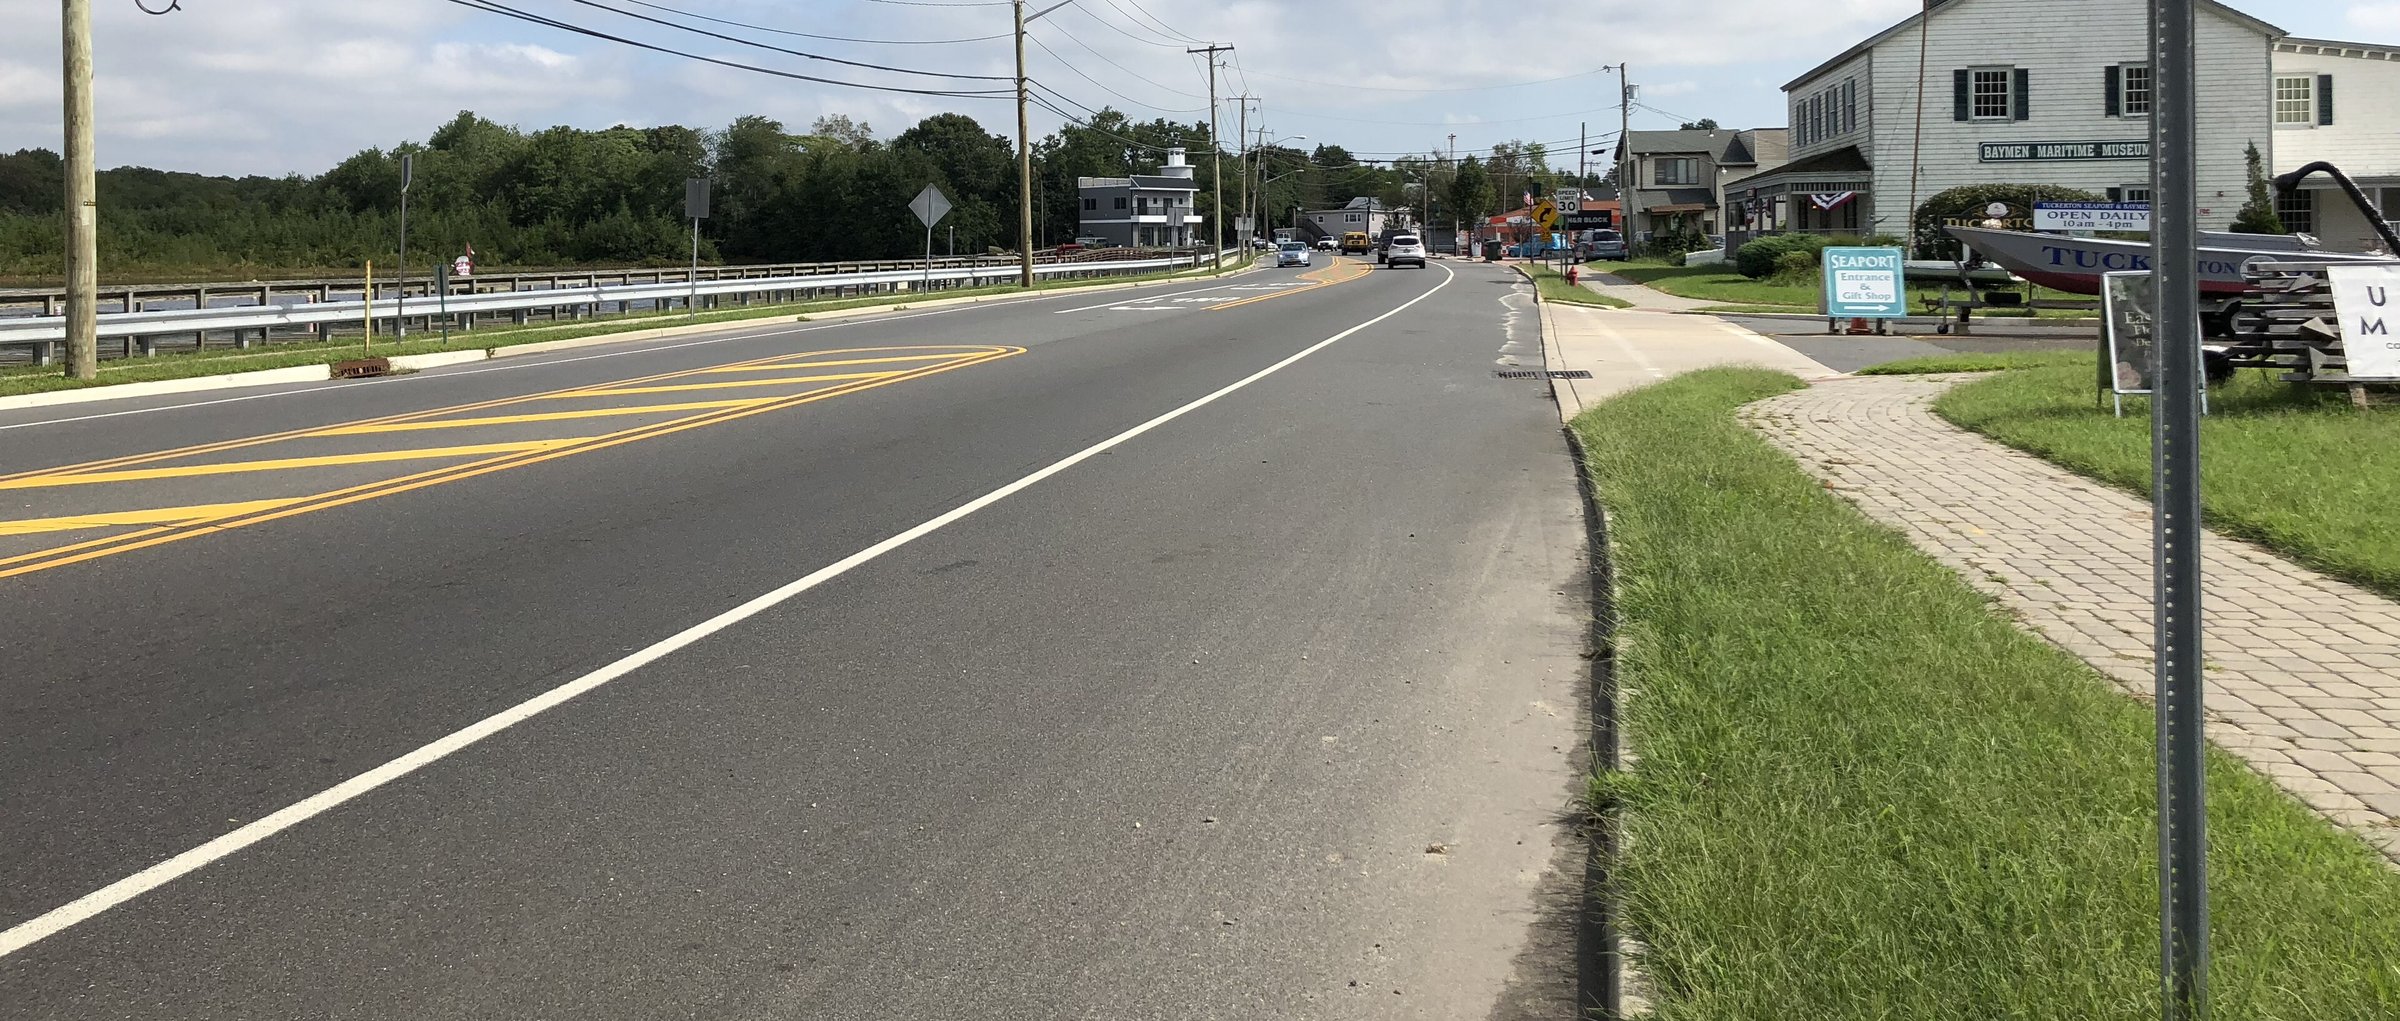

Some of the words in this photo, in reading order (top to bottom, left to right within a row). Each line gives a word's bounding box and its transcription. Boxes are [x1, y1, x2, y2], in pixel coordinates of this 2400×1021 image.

[1984, 146, 2029, 158] BAYMEN
[2037, 145, 2095, 157] MARITIME
[1558, 201, 1576, 211] 30
[2047, 211, 2092, 220] OPEN
[2100, 212, 2149, 220] DAILY
[1831, 255, 1896, 268] SEAPORT
[1841, 273, 1891, 281] Entrance
[1842, 292, 1862, 300] Gift
[1865, 292, 1891, 301] Shop
